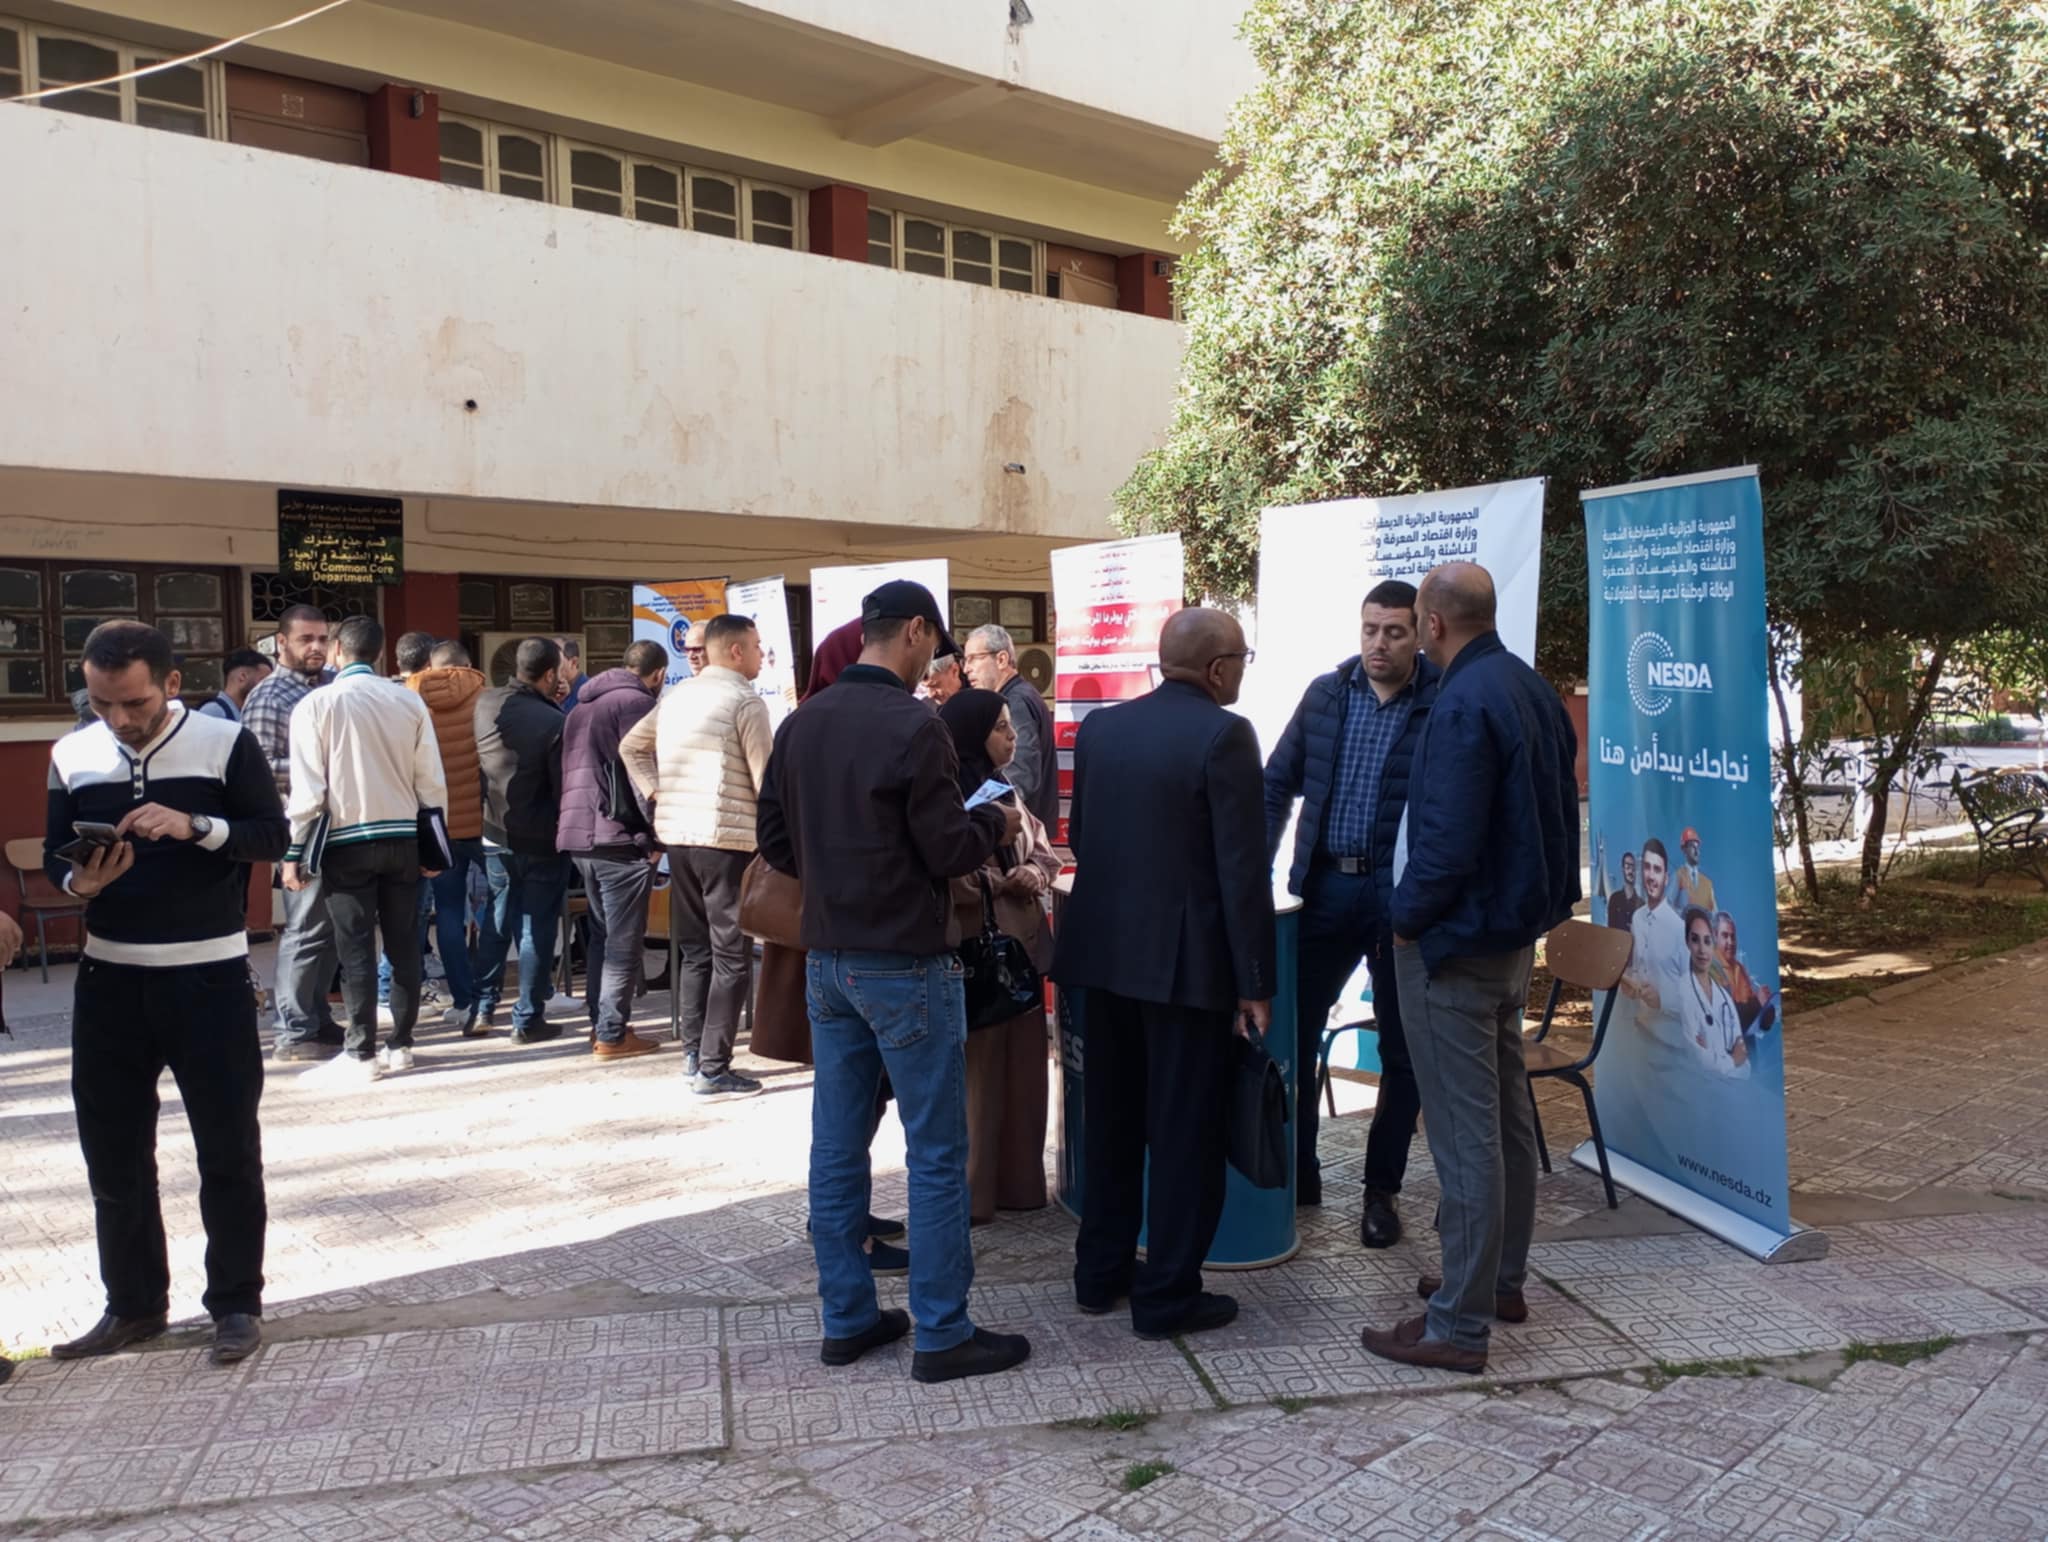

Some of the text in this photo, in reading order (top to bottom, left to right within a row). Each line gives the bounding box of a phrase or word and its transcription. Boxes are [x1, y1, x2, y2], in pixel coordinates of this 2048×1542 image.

[1405, 511, 1437, 528] الجزائرية
[1438, 507, 1479, 525] الجمهورية
[1383, 531, 1420, 546] المعرفة
[1422, 527, 1453, 542] اقتصاد
[1455, 525, 1478, 541] وزارة
[1602, 515, 1736, 544] الجمهورية الجزائرية الديمقراطية الشعبية
[304, 533, 339, 547] مشترك
[1438, 541, 1477, 557] الناشئة
[1602, 537, 1736, 561] وزارة اقتصاد المعرفة والمؤسسات
[294, 561, 395, 574] SNV Common Core
[1395, 562, 1415, 577] لدعم
[1602, 556, 1736, 579] الناشئة والمؤسسات المصغرة
[312, 572, 374, 584] Department
[1638, 585, 1660, 604] وتنمية
[1661, 583, 1680, 603] لدعم
[1680, 581, 1708, 603] الوطنية
[1709, 580, 1734, 602] الوكالة
[1647, 661, 1713, 689] NESDA
[1600, 736, 1625, 766] هنا
[1689, 748, 1750, 789] نجاحك
[1677, 1153, 1773, 1208] www.nesda.dz
